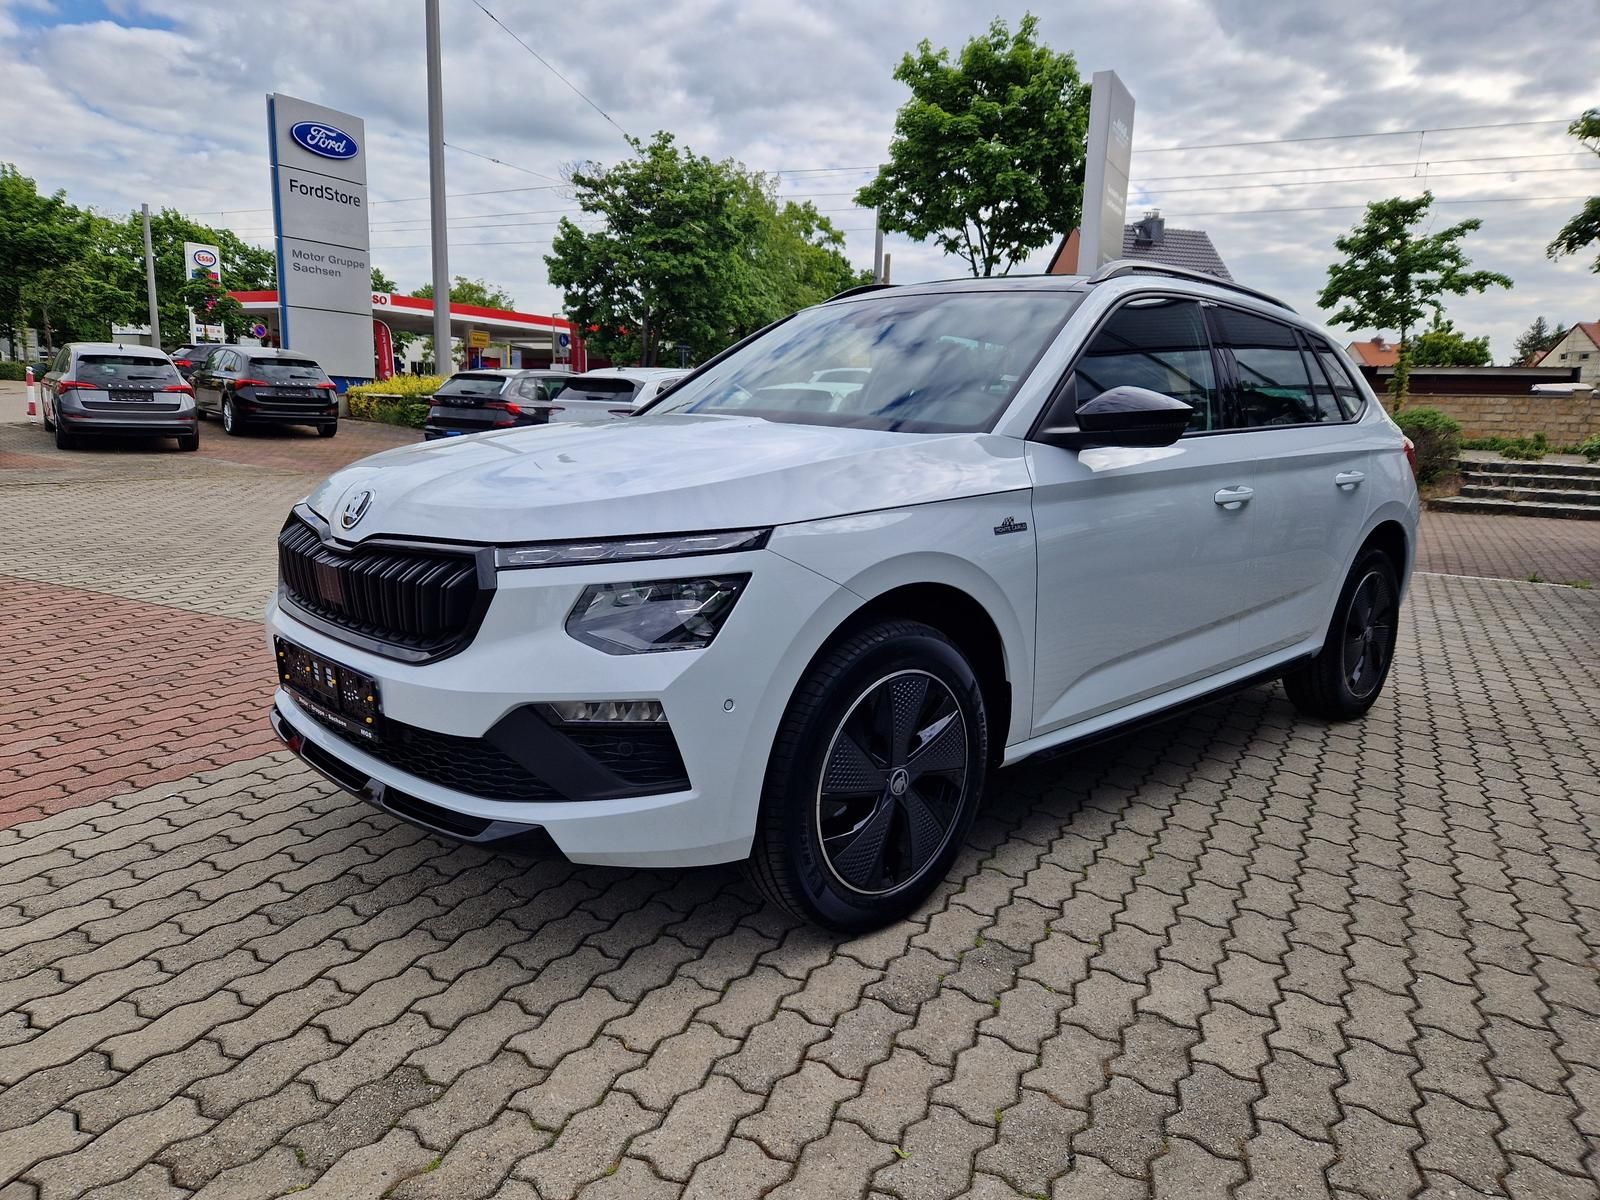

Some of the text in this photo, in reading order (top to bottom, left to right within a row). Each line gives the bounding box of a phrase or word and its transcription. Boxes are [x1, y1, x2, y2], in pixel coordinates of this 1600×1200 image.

[307, 126, 346, 153] Ford
[289, 178, 361, 207] FordStore
[292, 249, 365, 270] Motor Gruppe
[292, 262, 342, 278] Sachsen
